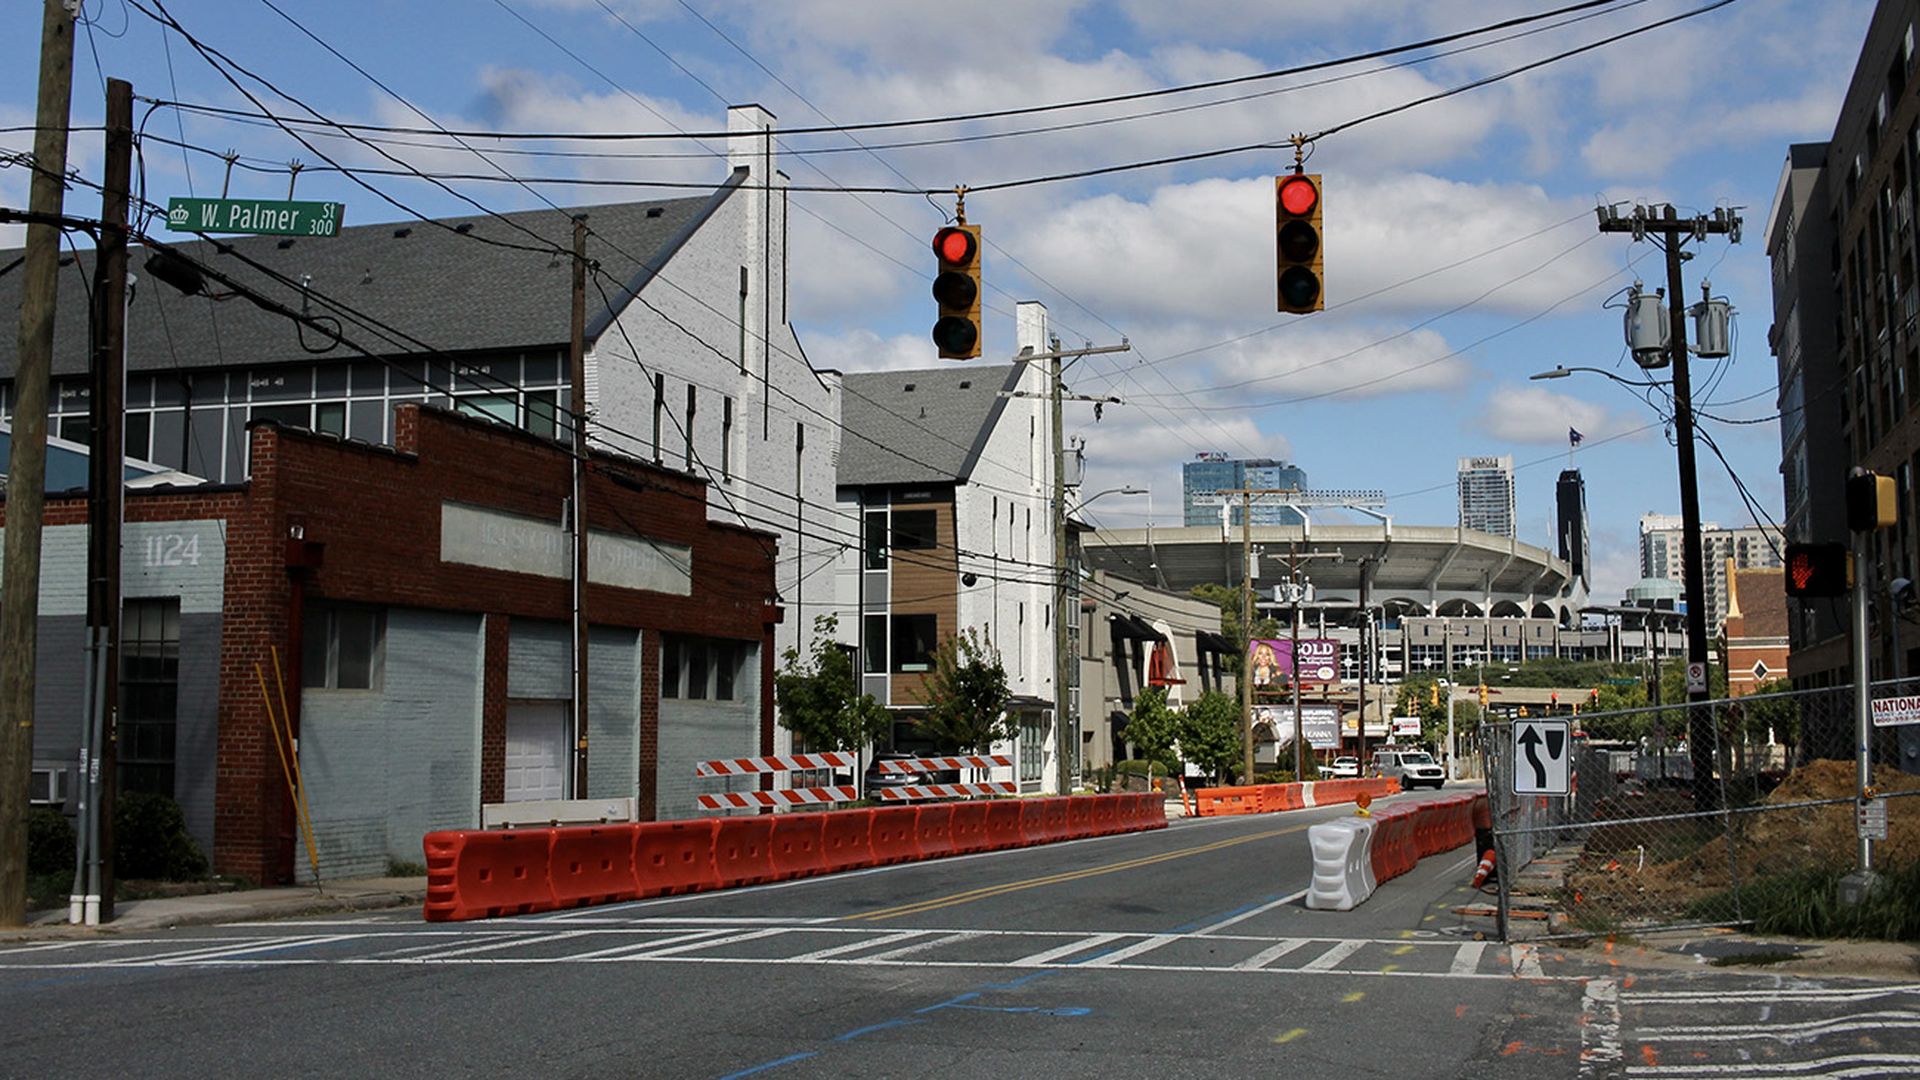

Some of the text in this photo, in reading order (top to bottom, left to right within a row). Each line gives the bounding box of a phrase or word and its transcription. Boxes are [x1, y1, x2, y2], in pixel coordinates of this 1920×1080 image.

[202, 203, 299, 230] W. Palmer
[322, 203, 335, 218] St
[309, 219, 334, 235] 300
[143, 534, 202, 568] 1124
